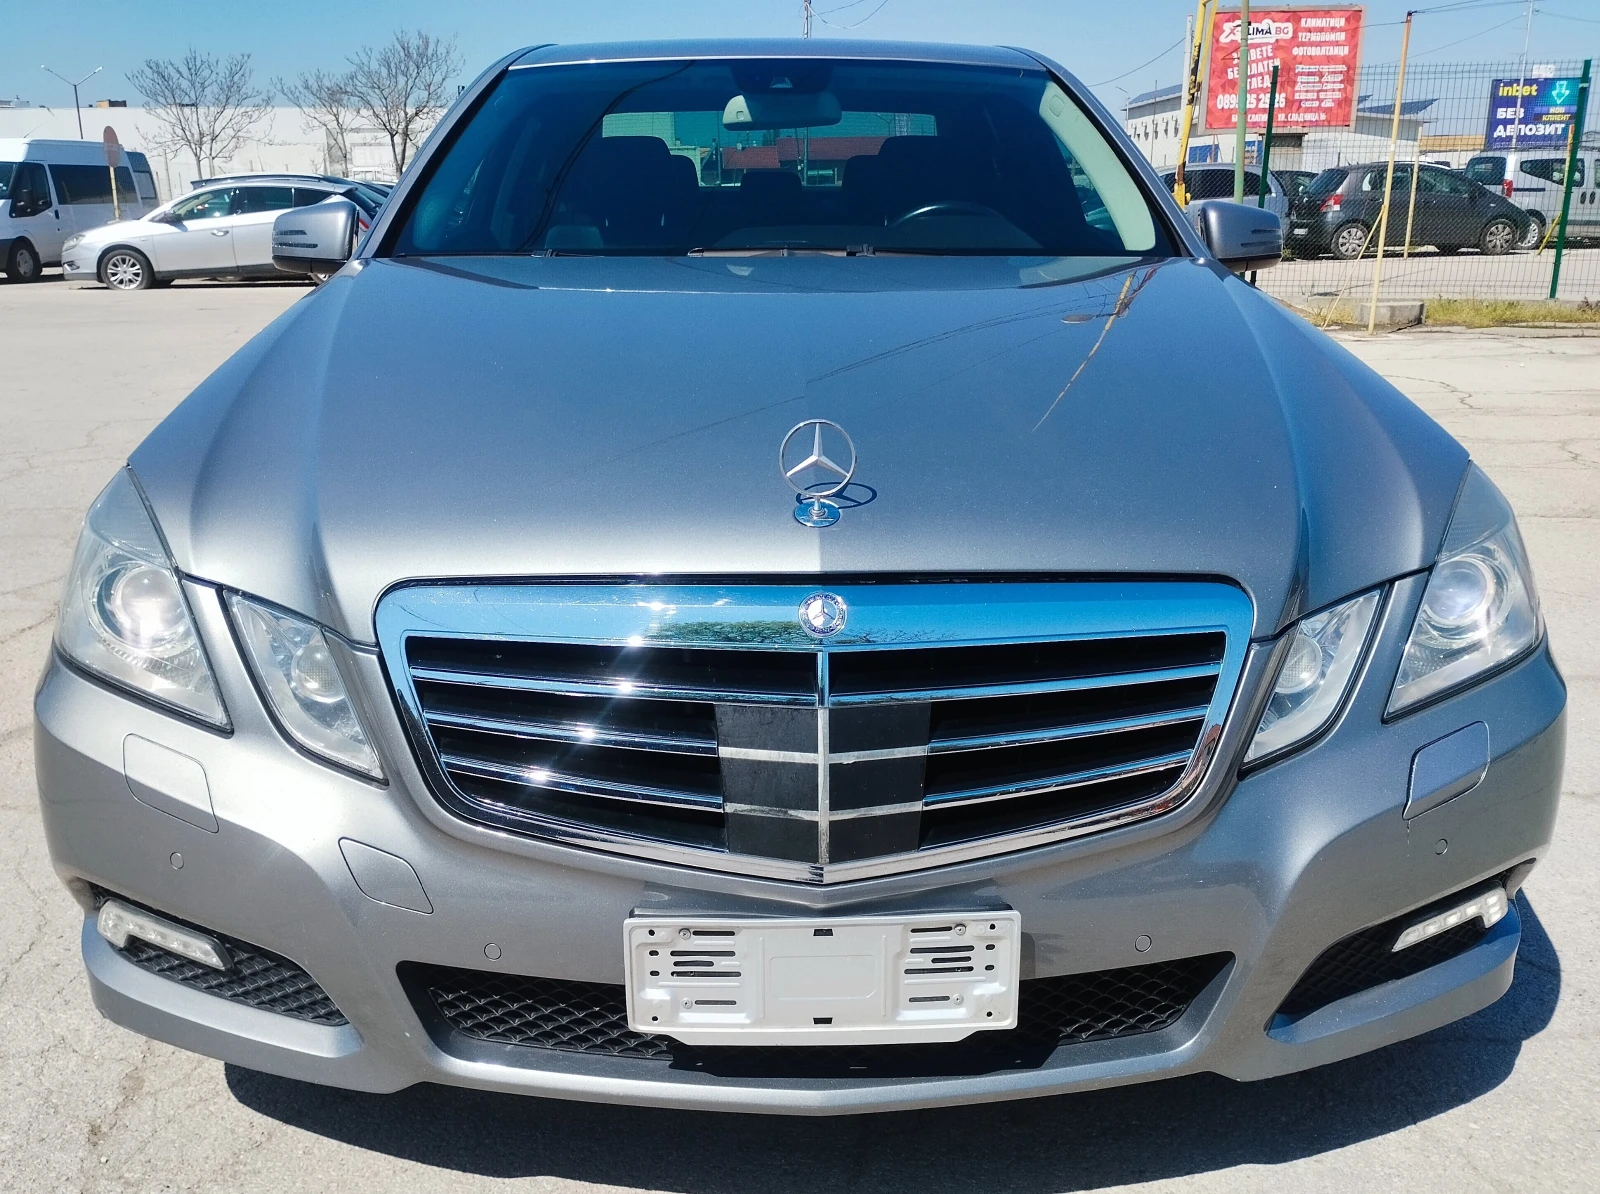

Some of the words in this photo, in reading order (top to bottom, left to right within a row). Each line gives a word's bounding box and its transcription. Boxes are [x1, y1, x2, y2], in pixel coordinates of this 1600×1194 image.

[1300, 17, 1345, 28] КЛИМАТИЦИ
[1298, 31, 1346, 42] ТЕРМОПОМПИ
[1227, 58, 1280, 80] БЕЛАТЕН
[1247, 74, 1271, 90] ГЛЕД
[1499, 83, 1538, 96] inbet
[1216, 94, 1238, 109] 089
[1497, 107, 1524, 119] БЕЗ
[1493, 124, 1566, 138] ДЕПОЗИТ
